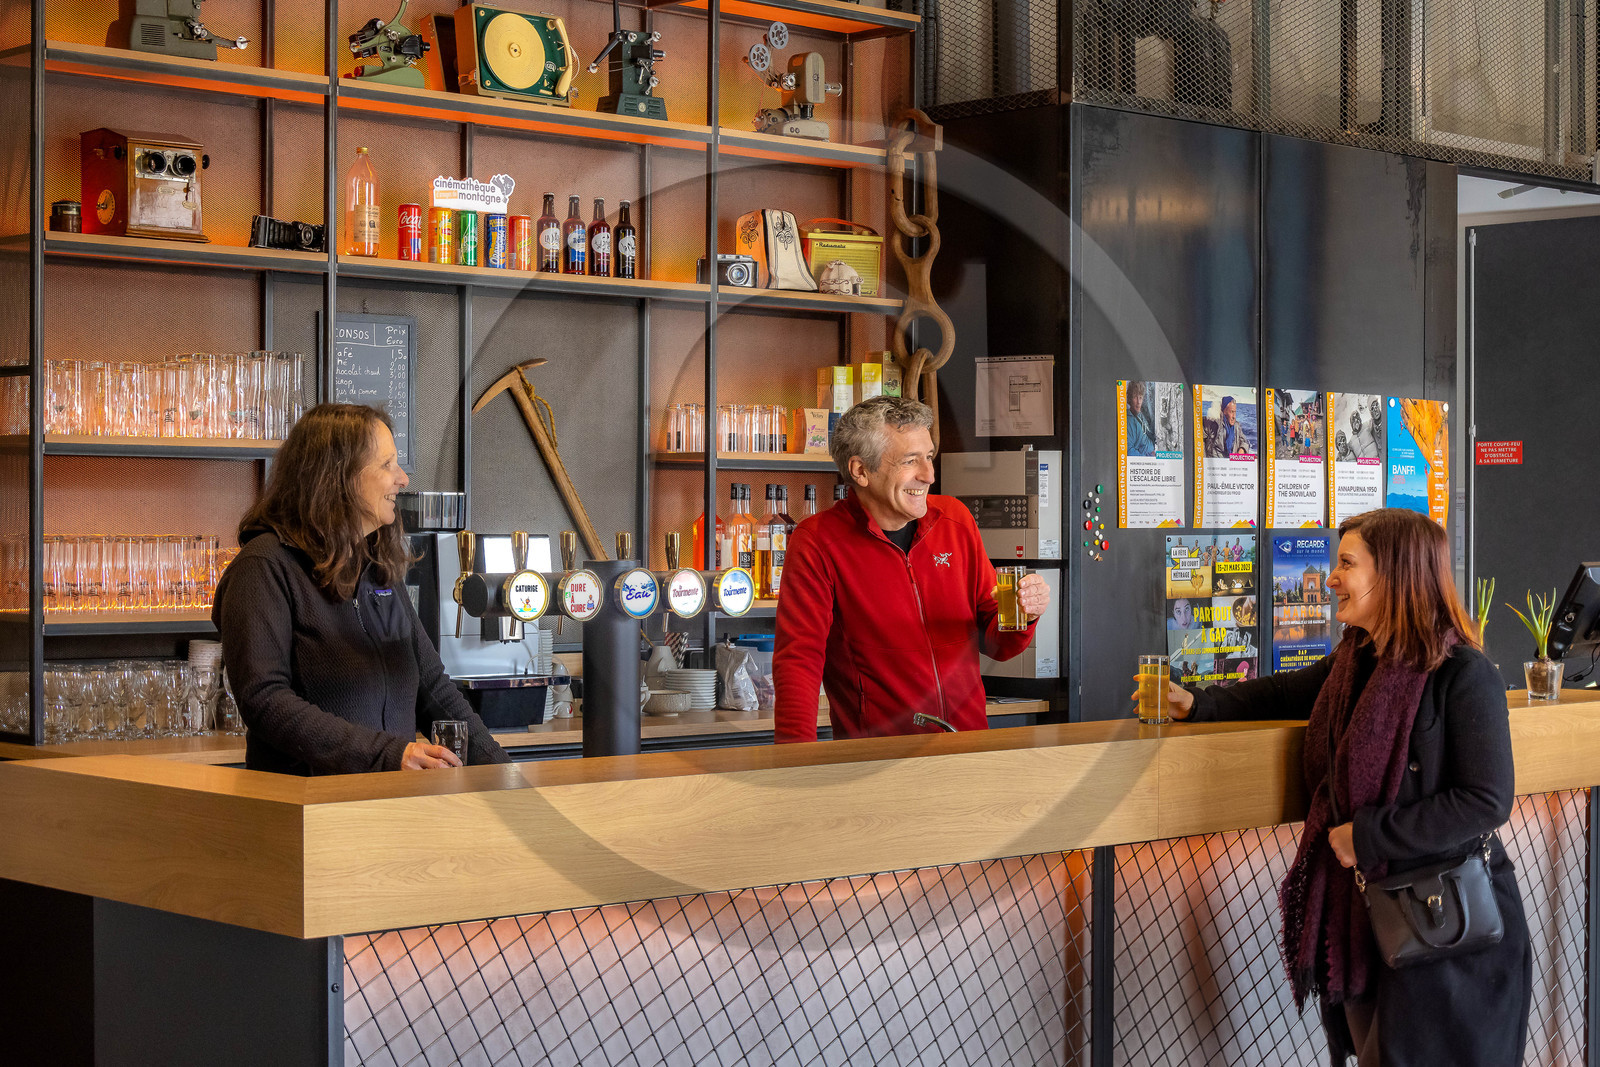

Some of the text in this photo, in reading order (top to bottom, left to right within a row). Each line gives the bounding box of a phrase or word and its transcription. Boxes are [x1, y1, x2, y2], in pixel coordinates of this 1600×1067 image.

[434, 177, 496, 196] cinémathèque
[458, 192, 501, 205] montagne
[385, 326, 406, 336] Prix
[386, 336, 404, 345] Euro
[336, 346, 353, 358] afé
[336, 357, 348, 366] hé
[336, 364, 361, 376] hocolat
[1207, 481, 1236, 490] PAUL-ÉMILE
[1296, 540, 1325, 549] REGARDS
[1186, 559, 1199, 567] COURT
[1240, 563, 1251, 571] 2023
[515, 584, 539, 593] CATURIGE
[571, 583, 586, 593] DURE
[672, 588, 699, 598] Tourmente
[723, 587, 747, 597] Tourmente
[626, 588, 652, 601] Eau
[1193, 606, 1232, 622] PARTOUT
[1283, 605, 1322, 618] MAROC
[1201, 626, 1227, 643] À GAP
